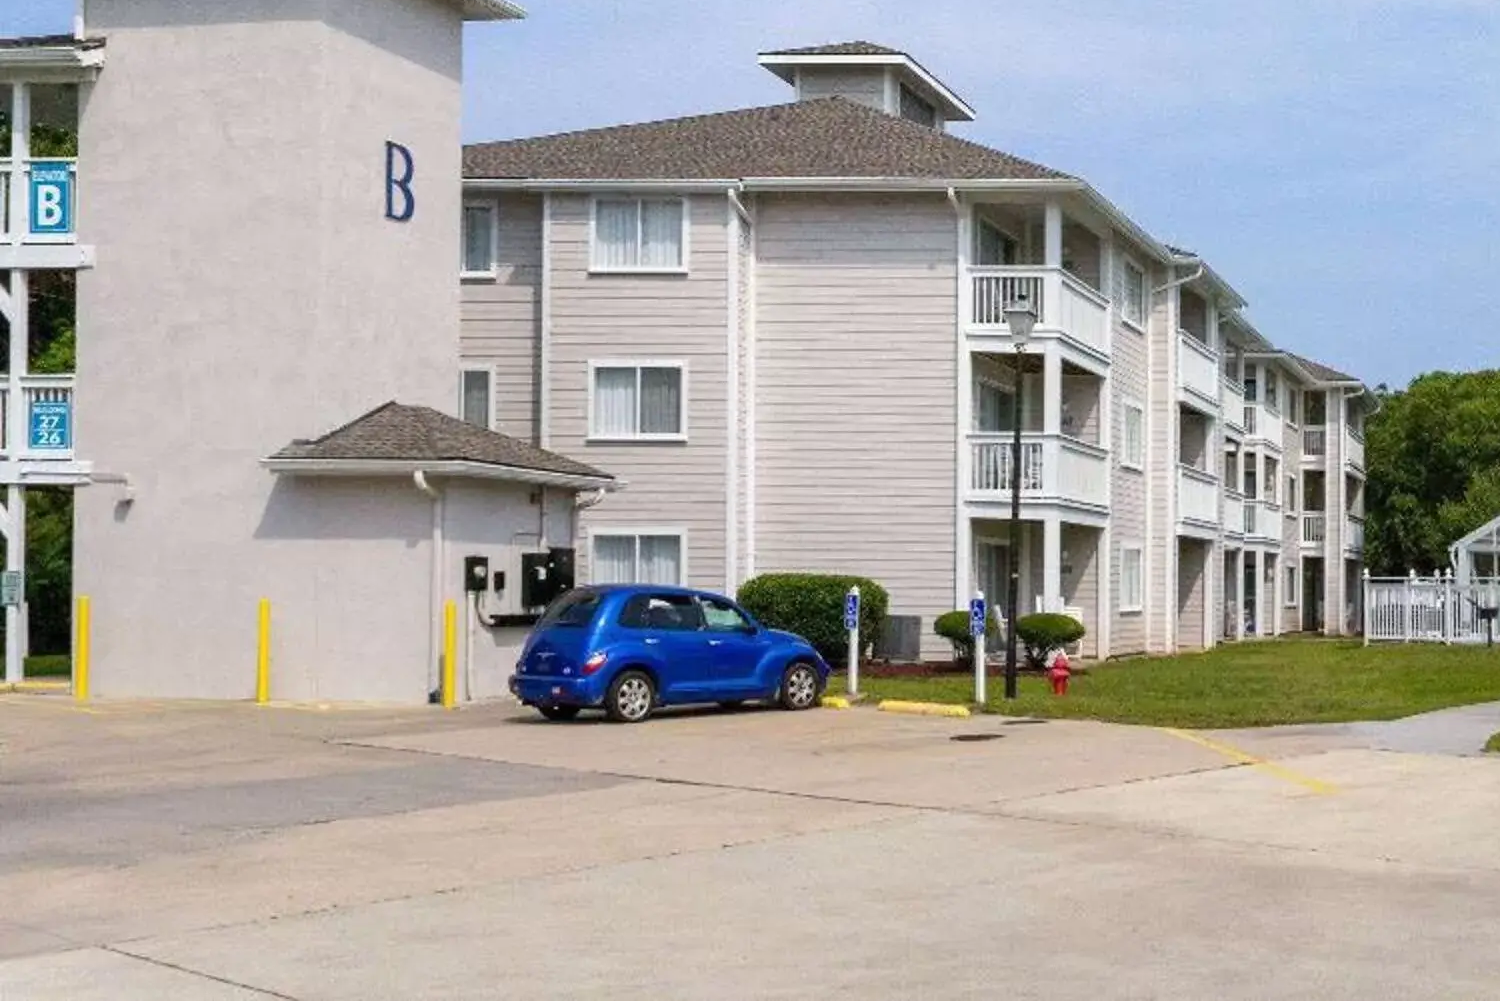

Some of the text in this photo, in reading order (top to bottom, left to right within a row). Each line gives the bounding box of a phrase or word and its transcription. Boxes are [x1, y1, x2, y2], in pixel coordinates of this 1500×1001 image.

[385, 140, 415, 221] B
[37, 184, 63, 226] B
[39, 416, 60, 429] 27
[38, 430, 61, 444] 26
